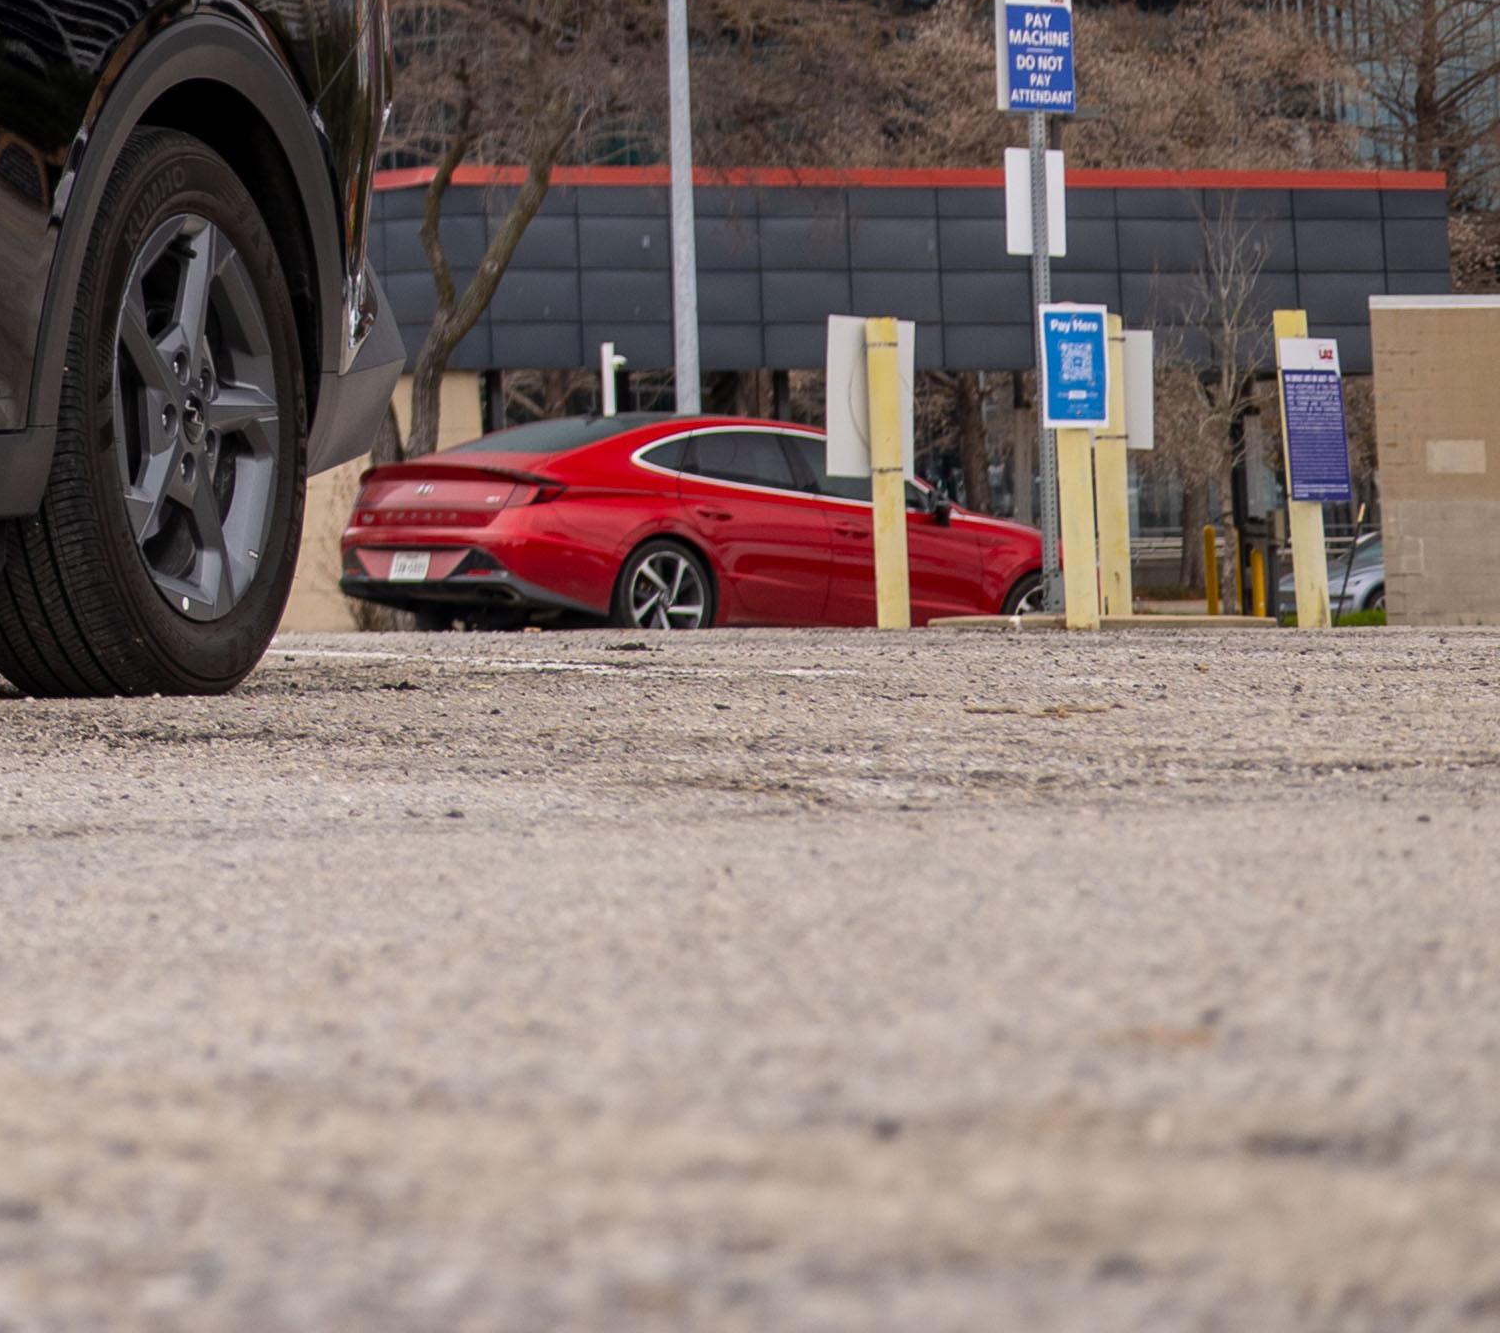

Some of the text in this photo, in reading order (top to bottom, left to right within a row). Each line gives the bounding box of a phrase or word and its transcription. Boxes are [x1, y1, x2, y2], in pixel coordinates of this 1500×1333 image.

[1025, 13, 1052, 29] PAY
[1009, 29, 1070, 47] MACHINE
[1016, 54, 1064, 71] DO NOT
[1029, 73, 1052, 87] PAY
[1011, 88, 1073, 105] ATTENDANT
[124, 165, 187, 253] KUMHO
